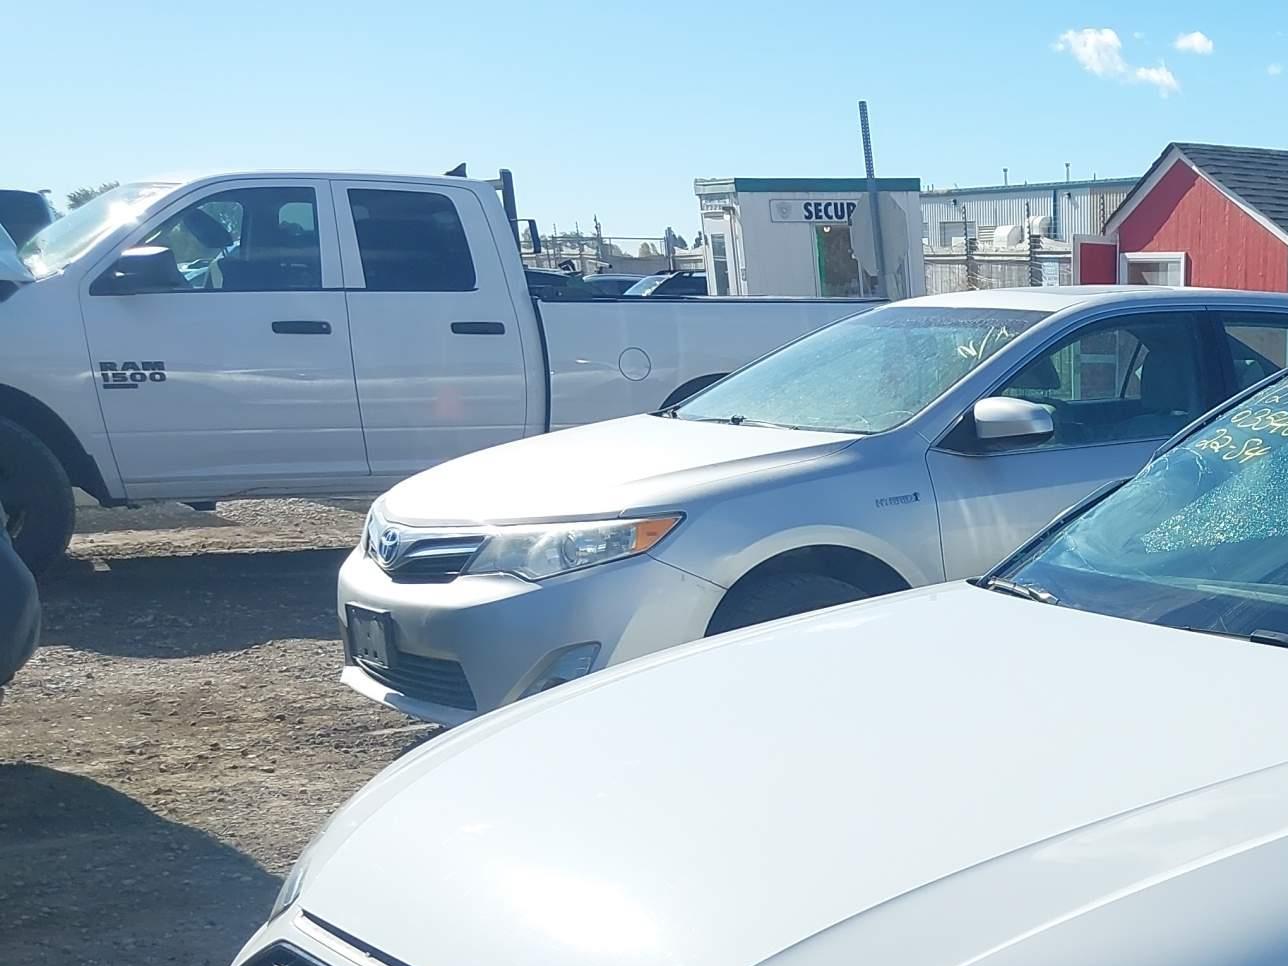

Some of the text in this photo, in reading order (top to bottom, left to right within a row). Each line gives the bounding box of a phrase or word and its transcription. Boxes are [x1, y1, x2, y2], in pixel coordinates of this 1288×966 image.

[803, 201, 857, 221] SECUR
[99, 361, 166, 372] RAM
[101, 372, 167, 383] 1500
